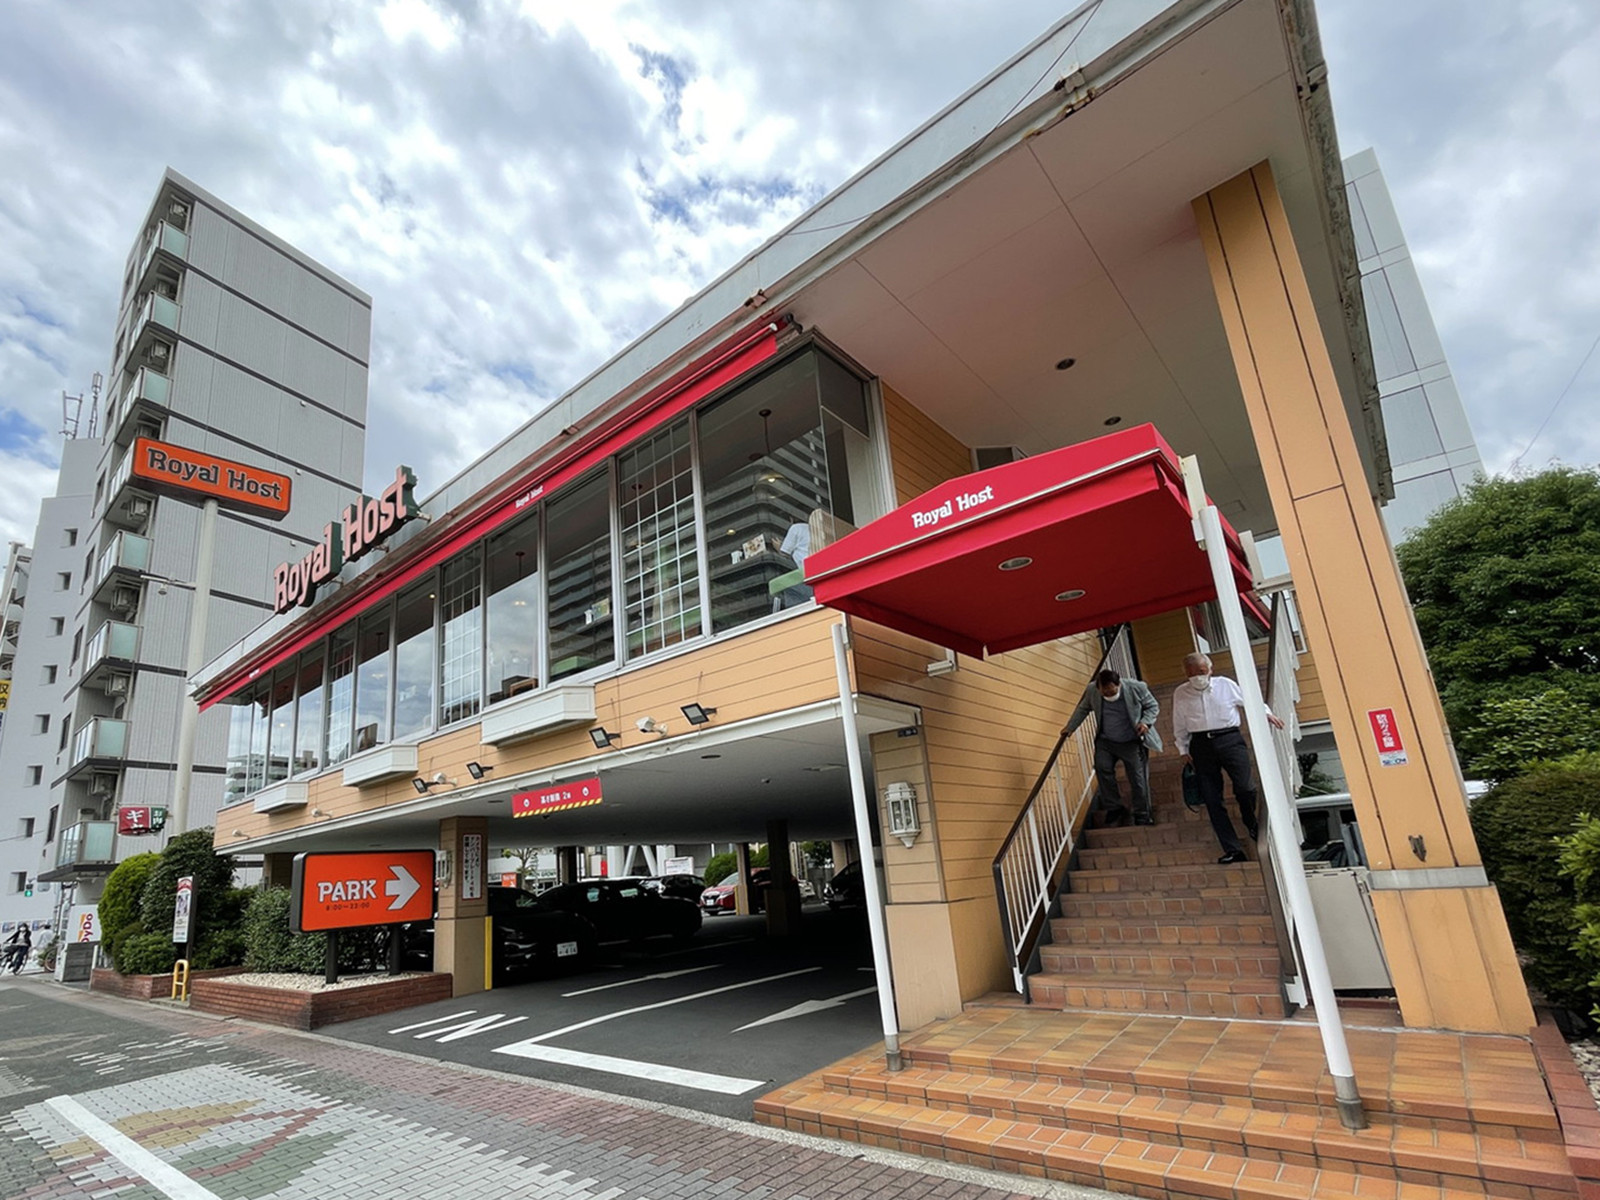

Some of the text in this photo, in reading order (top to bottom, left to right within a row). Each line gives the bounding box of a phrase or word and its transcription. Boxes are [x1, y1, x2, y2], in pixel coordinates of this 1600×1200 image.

[147, 447, 282, 501] Royal Host
[911, 485, 995, 529] Royal Host
[273, 465, 410, 612] Royal Host
[317, 879, 377, 903] PARK
